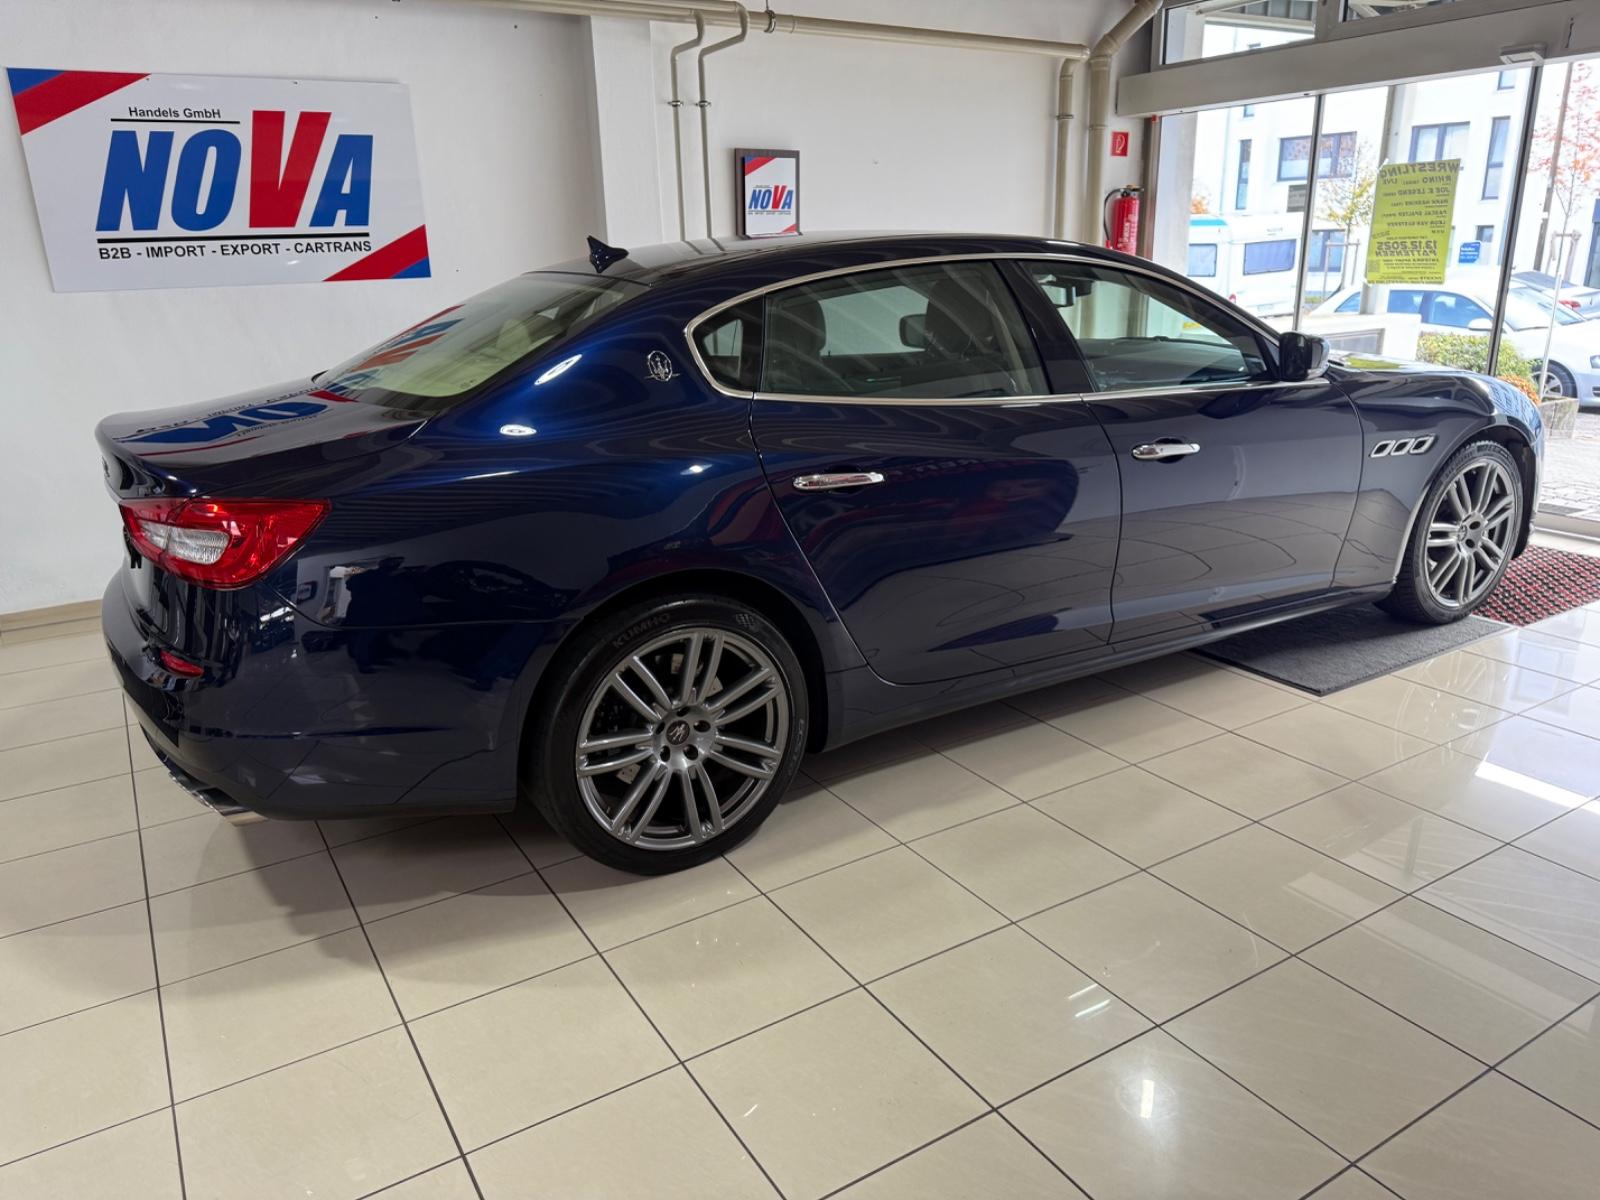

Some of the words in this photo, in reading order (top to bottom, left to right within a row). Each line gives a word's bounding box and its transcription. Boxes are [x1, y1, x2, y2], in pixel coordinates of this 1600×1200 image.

[128, 106, 180, 119] Handels
[183, 107, 222, 120] GmbH
[95, 109, 374, 232] NOVA
[747, 184, 794, 210] NOVA
[99, 247, 132, 260] B2B
[145, 244, 206, 259] IMPORT
[220, 242, 281, 257] EXPORT
[294, 240, 373, 255] CARTRANS
[612, 613, 672, 649] KUMHO
